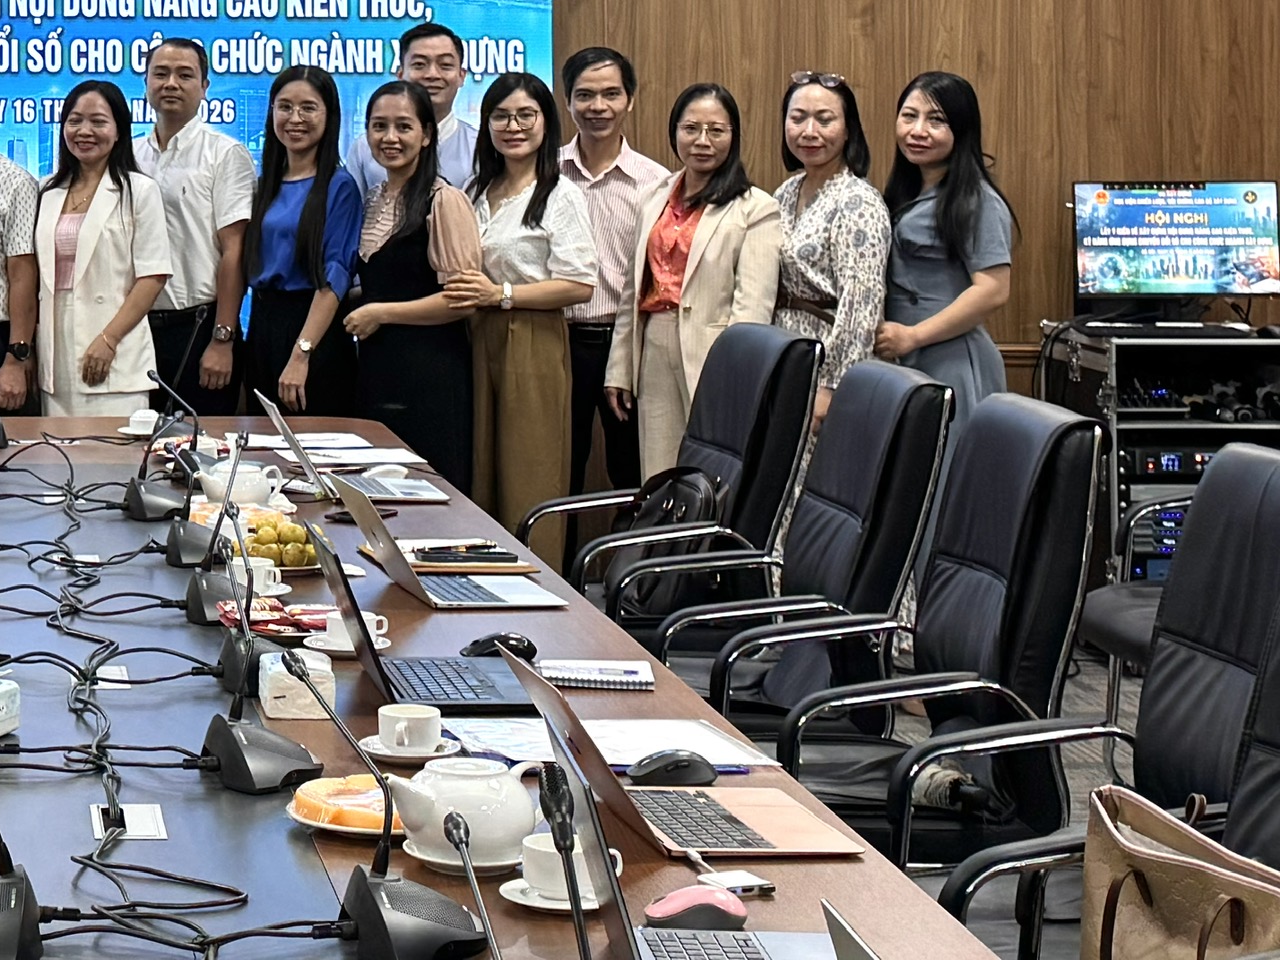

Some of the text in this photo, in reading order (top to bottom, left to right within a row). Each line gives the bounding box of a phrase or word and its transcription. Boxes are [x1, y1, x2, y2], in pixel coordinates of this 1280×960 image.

[27, 27, 63, 73] SỐ
[71, 38, 124, 74] CHO
[211, 31, 284, 74] CHỨC
[290, 31, 384, 74] NGÀNH
[13, 99, 36, 123] 16
